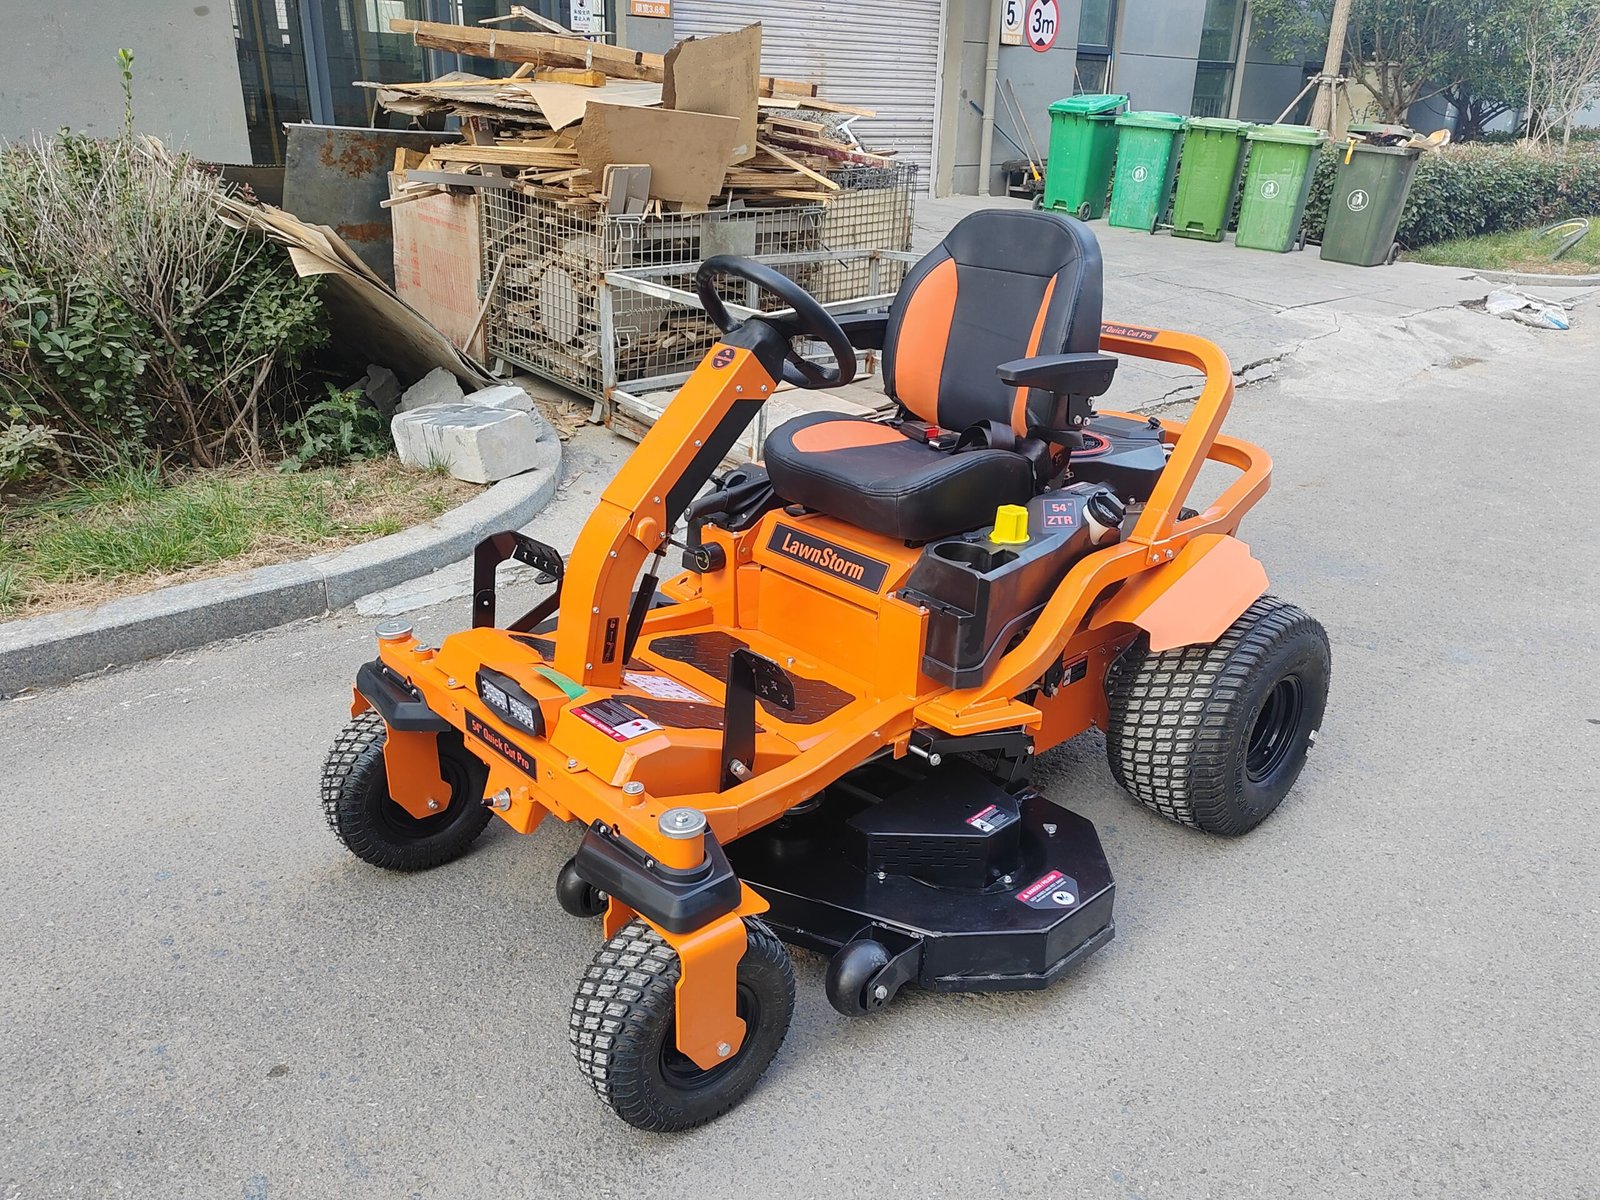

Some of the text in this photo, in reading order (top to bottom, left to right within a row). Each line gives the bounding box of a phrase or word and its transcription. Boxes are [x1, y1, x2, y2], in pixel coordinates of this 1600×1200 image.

[1006, 1, 1016, 26] 5
[1032, 8, 1055, 34] 3m
[1106, 326, 1126, 335] Quick
[1126, 329, 1140, 337] Cut
[1139, 331, 1153, 340] Pro
[1047, 515, 1073, 525] ZTR
[1051, 502, 1073, 513] 54"
[781, 532, 865, 580] LawnStorm
[471, 719, 530, 770] 54" Quick Cut Pro
